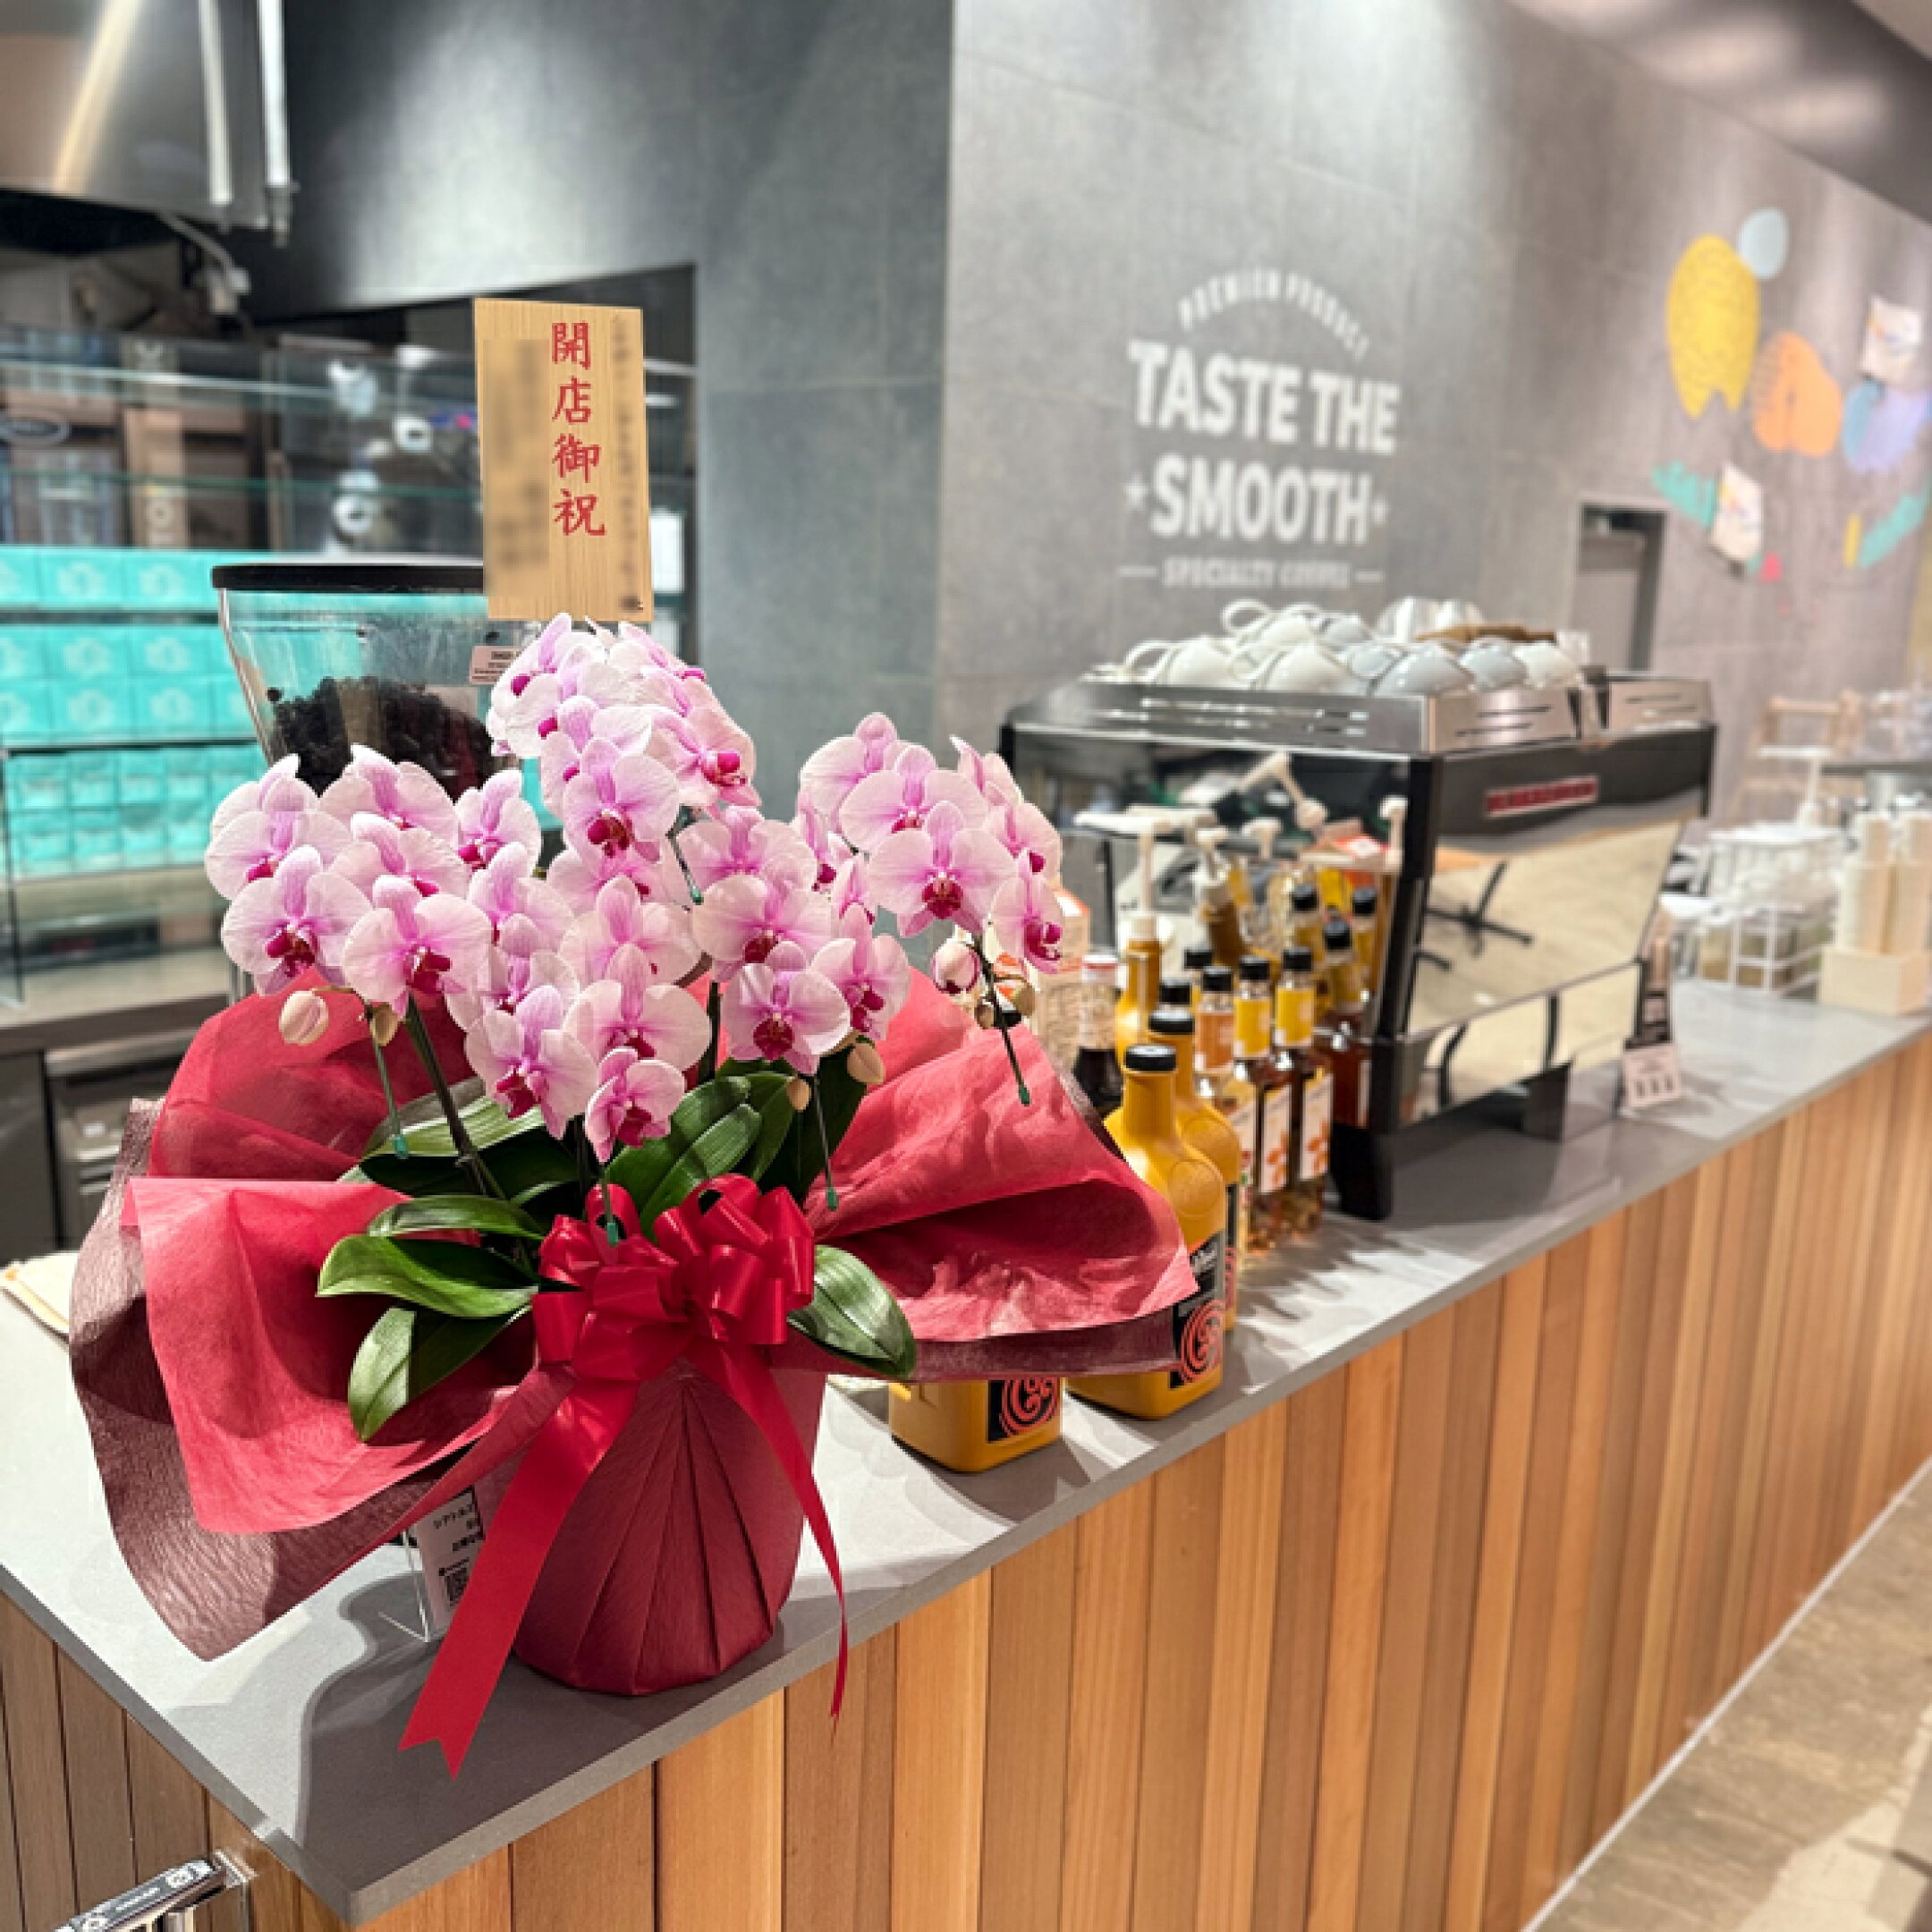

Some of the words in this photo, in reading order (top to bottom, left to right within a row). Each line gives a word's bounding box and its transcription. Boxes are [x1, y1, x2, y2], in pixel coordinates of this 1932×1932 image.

[551, 320, 606, 537] 開店御祝
[1127, 338, 1302, 445] TASTE
[1309, 368, 1402, 456] THE
[1150, 452, 1372, 547] SMOOTH
